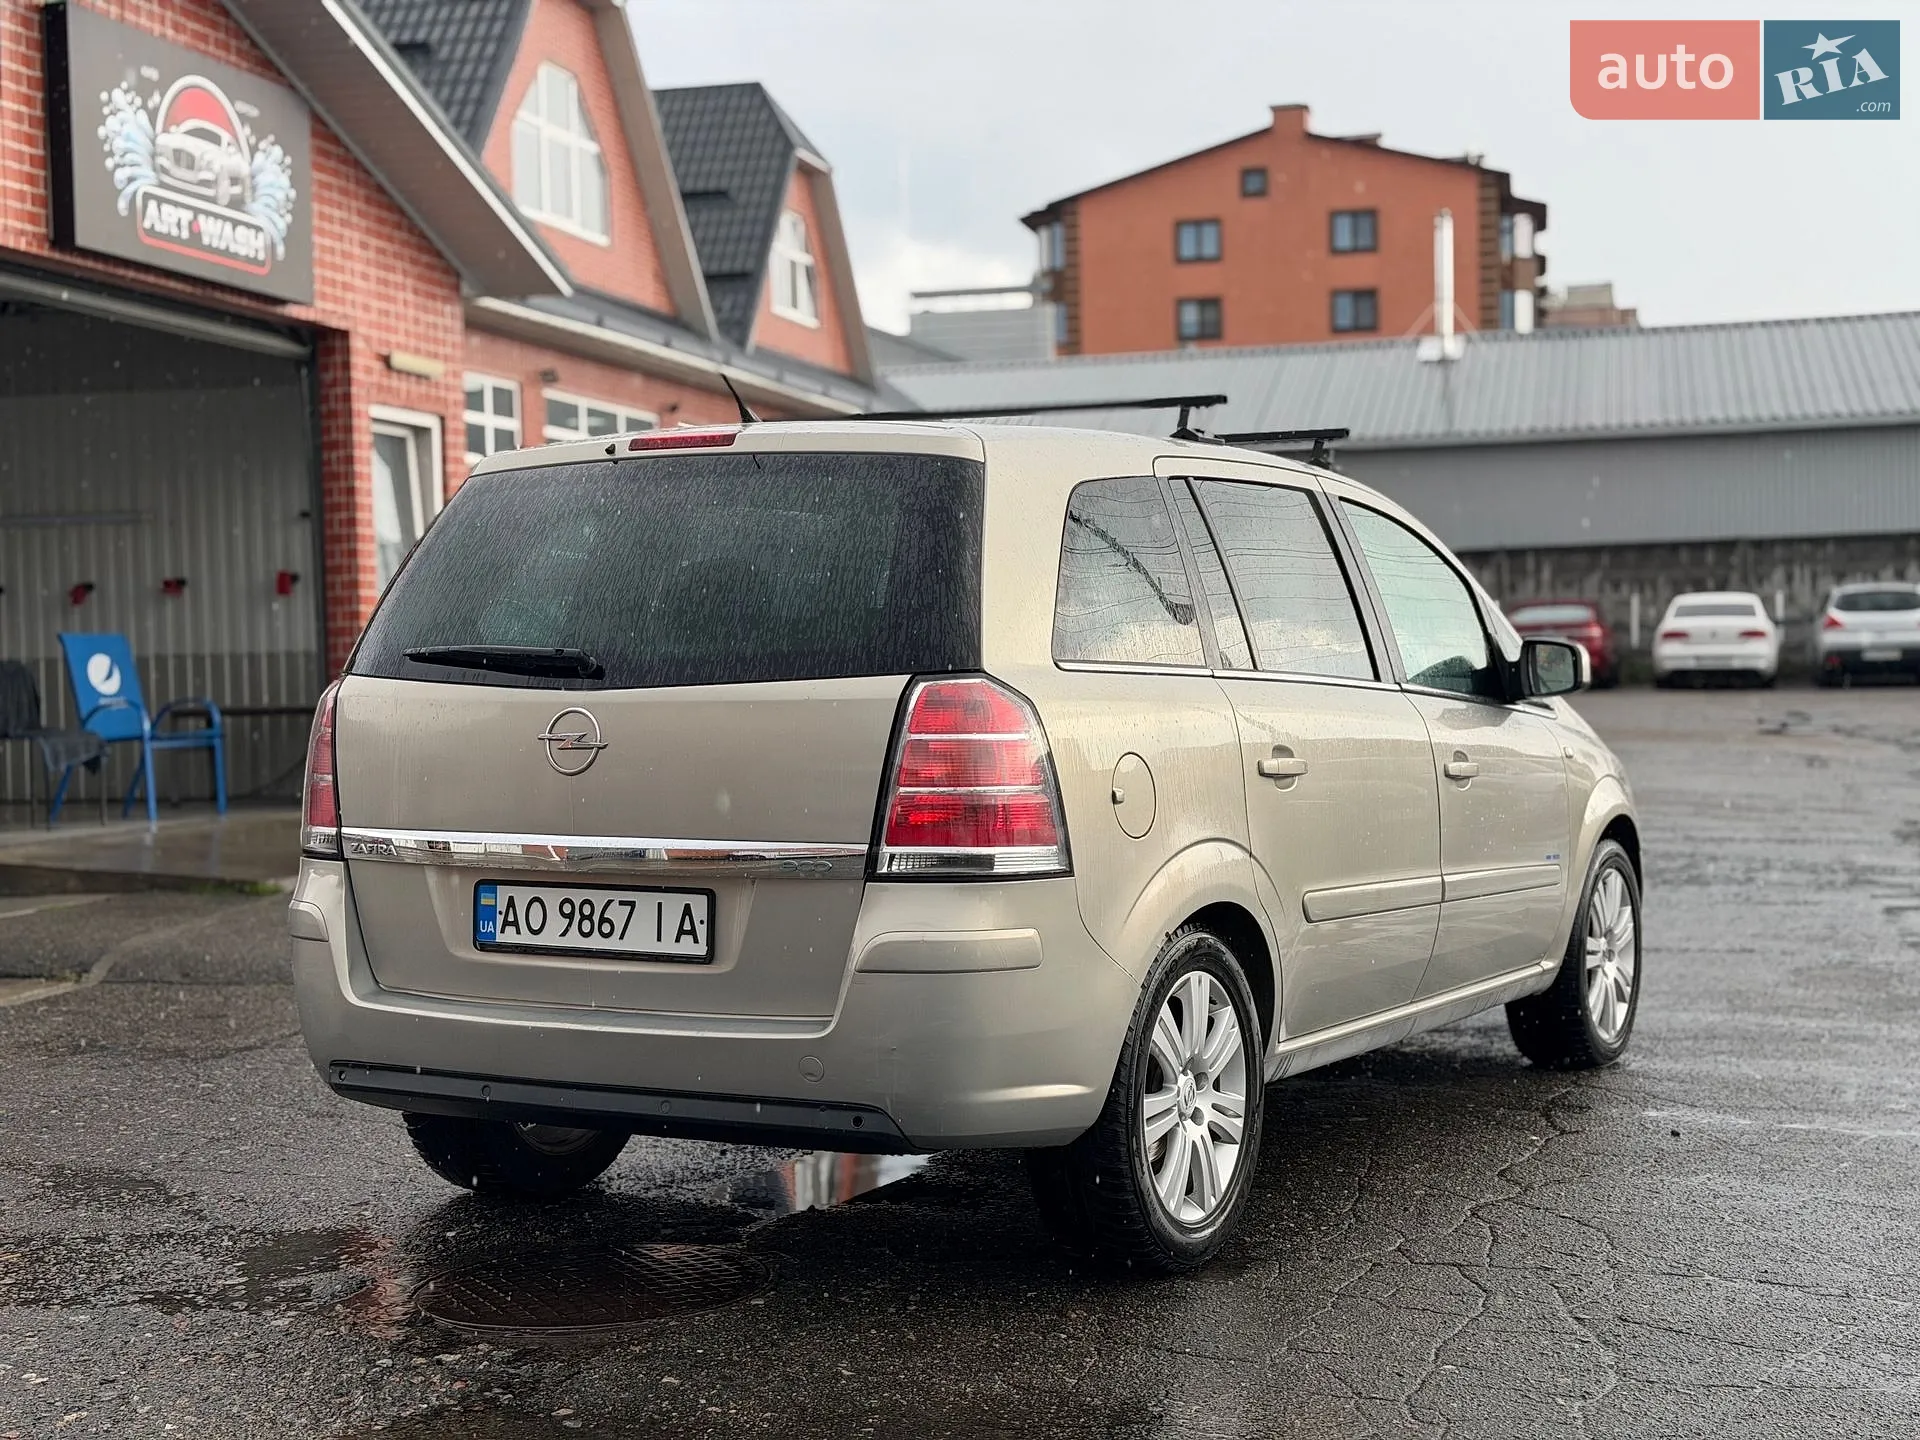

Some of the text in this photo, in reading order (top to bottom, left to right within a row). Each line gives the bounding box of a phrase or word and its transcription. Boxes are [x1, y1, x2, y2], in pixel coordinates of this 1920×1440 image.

[142, 199, 266, 261] ART WASH
[351, 842, 398, 856] ZAFIRA
[480, 920, 495, 933] UA
[500, 895, 548, 936] AO
[558, 897, 637, 941] 9867
